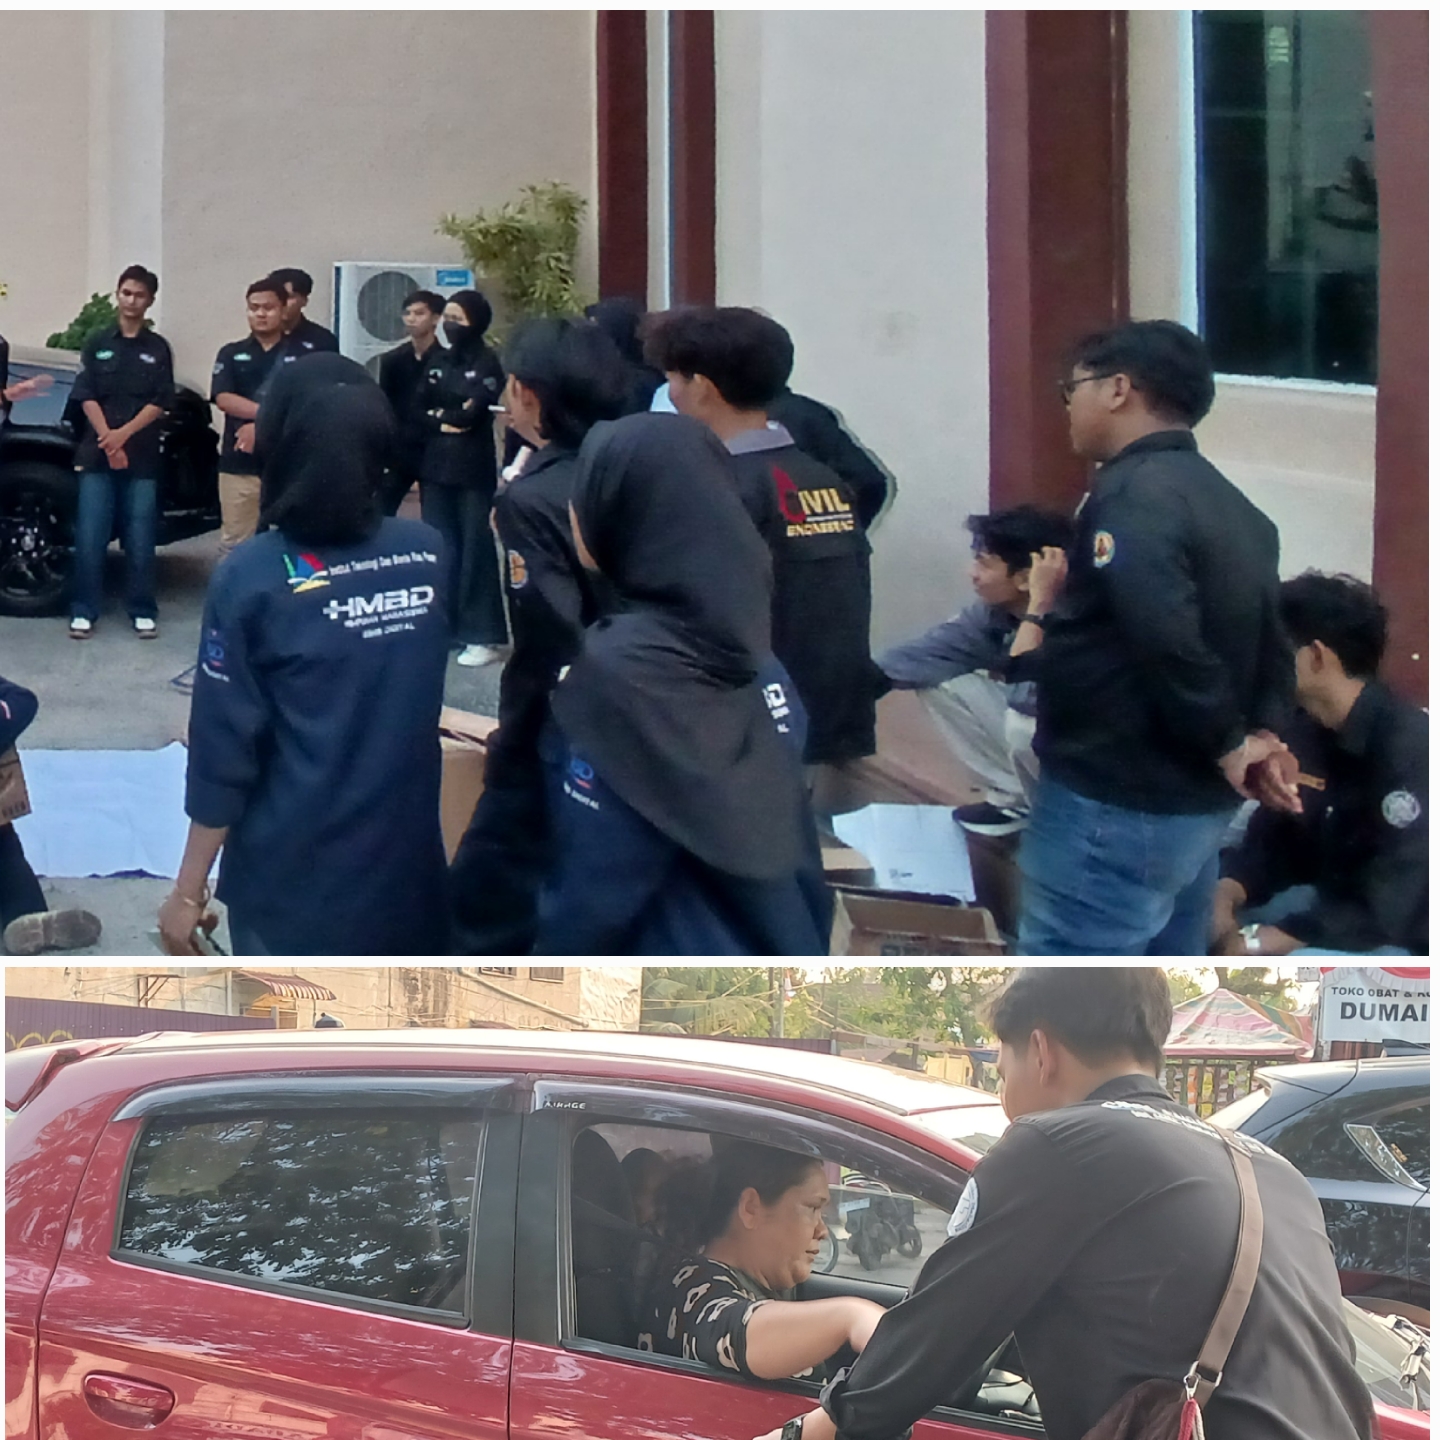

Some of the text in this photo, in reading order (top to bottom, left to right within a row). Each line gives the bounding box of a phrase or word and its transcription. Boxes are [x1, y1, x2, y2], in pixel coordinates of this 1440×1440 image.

[323, 585, 434, 620] HMBD
[1331, 987, 1364, 996] TOKO
[1368, 989, 1399, 998] OBAT
[1340, 1002, 1427, 1022] DUMAI
